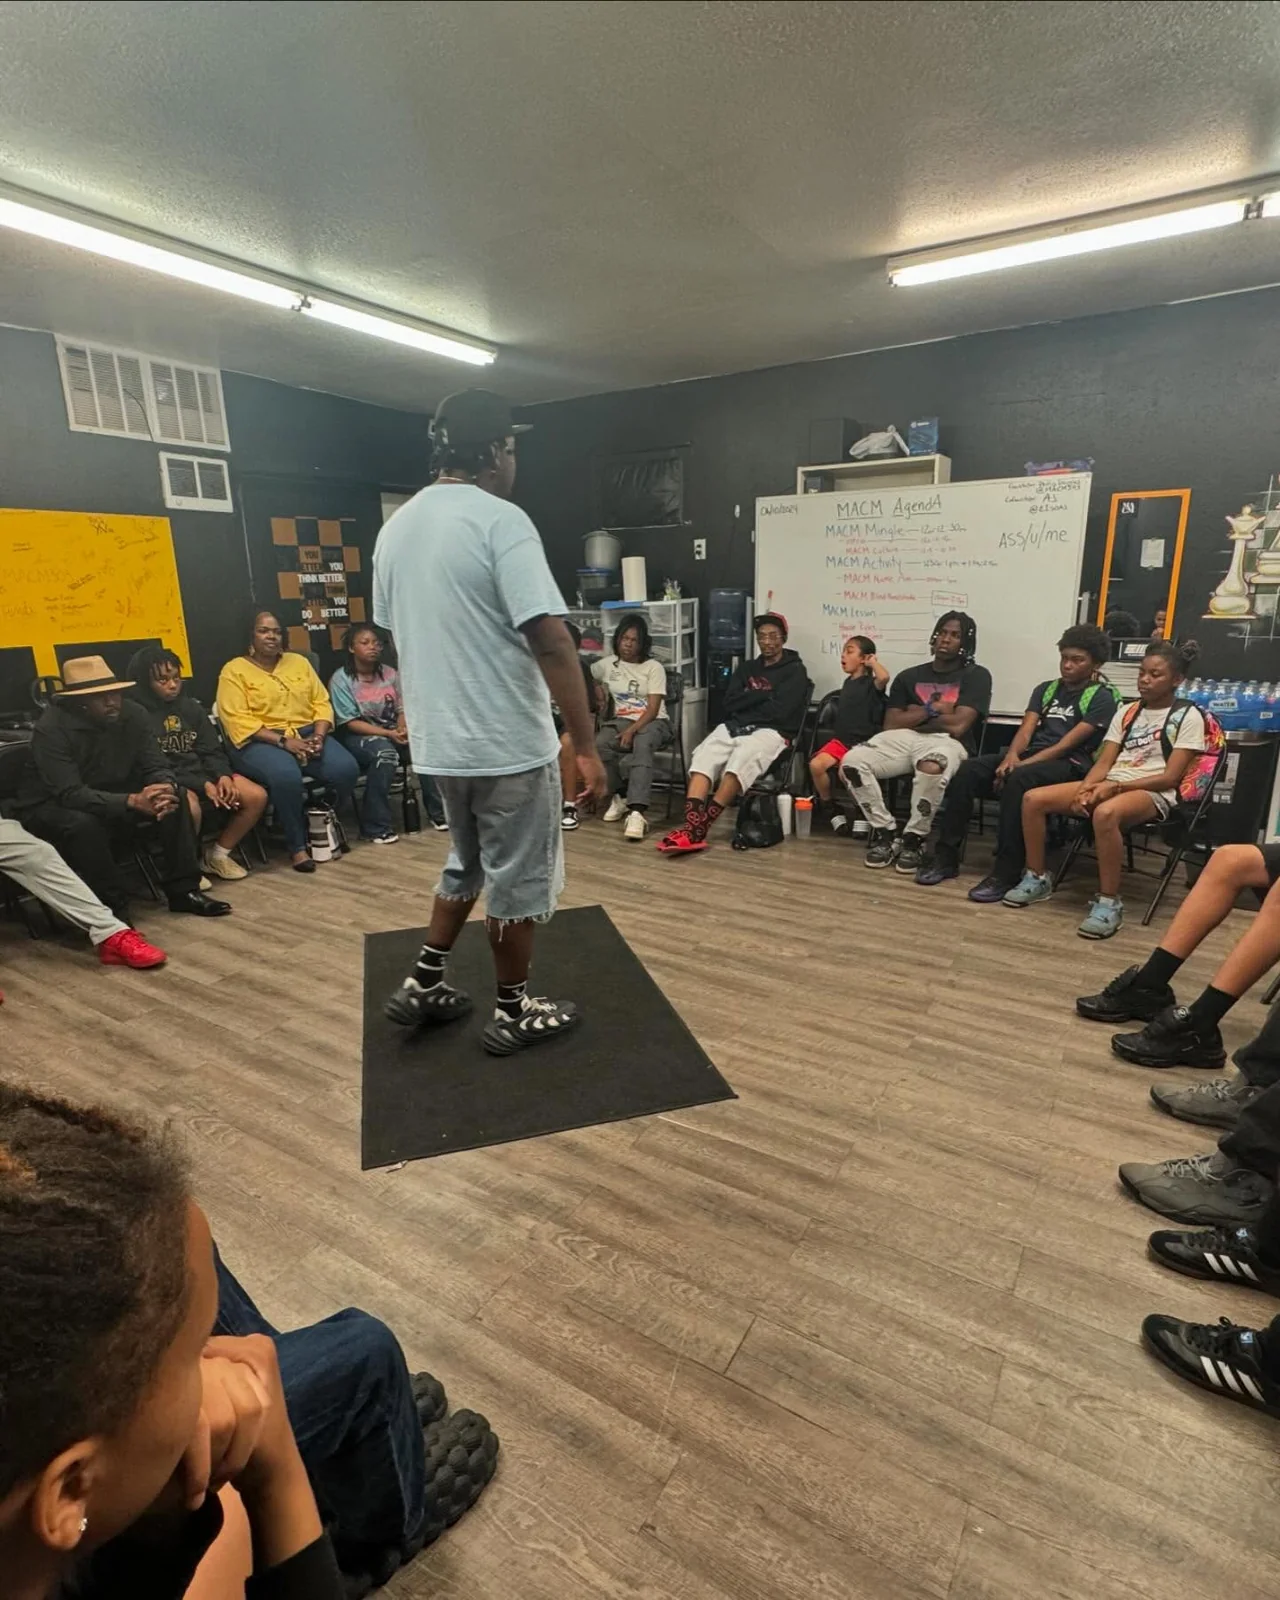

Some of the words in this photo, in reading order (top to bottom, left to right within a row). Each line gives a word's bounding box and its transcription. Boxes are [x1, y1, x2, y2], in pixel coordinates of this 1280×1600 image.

[836, 499, 884, 519] MACM
[825, 525, 860, 538] MACM
[328, 562, 344, 571] YOU
[825, 556, 859, 569] MACM
[297, 573, 319, 583] THINK
[843, 573, 871, 584] MACM
[843, 590, 868, 601] MACM
[334, 597, 347, 606] YOU
[302, 610, 313, 619] DO
[822, 603, 848, 617] MACM
